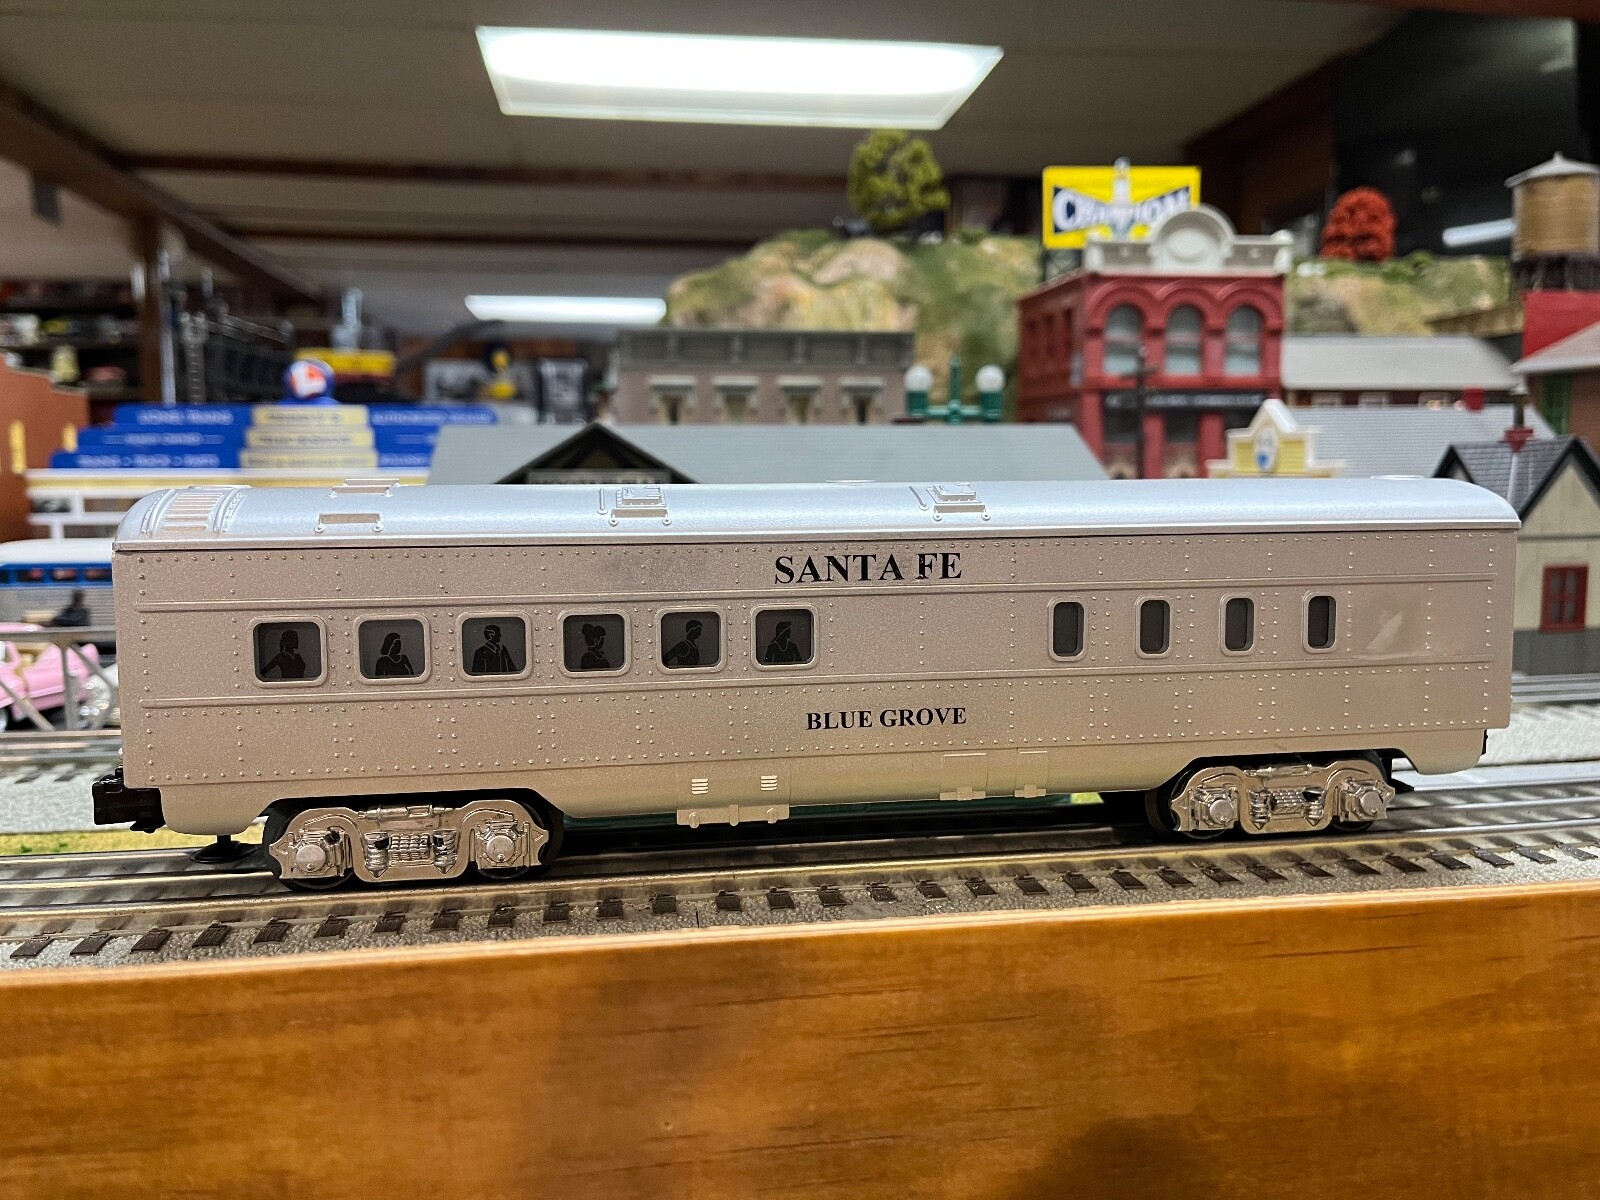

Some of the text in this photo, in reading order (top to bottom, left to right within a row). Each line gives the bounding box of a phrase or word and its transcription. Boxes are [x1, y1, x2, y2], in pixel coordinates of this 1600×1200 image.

[775, 552, 962, 584] SANTA FE
[806, 708, 966, 730] BLUE GROVE
